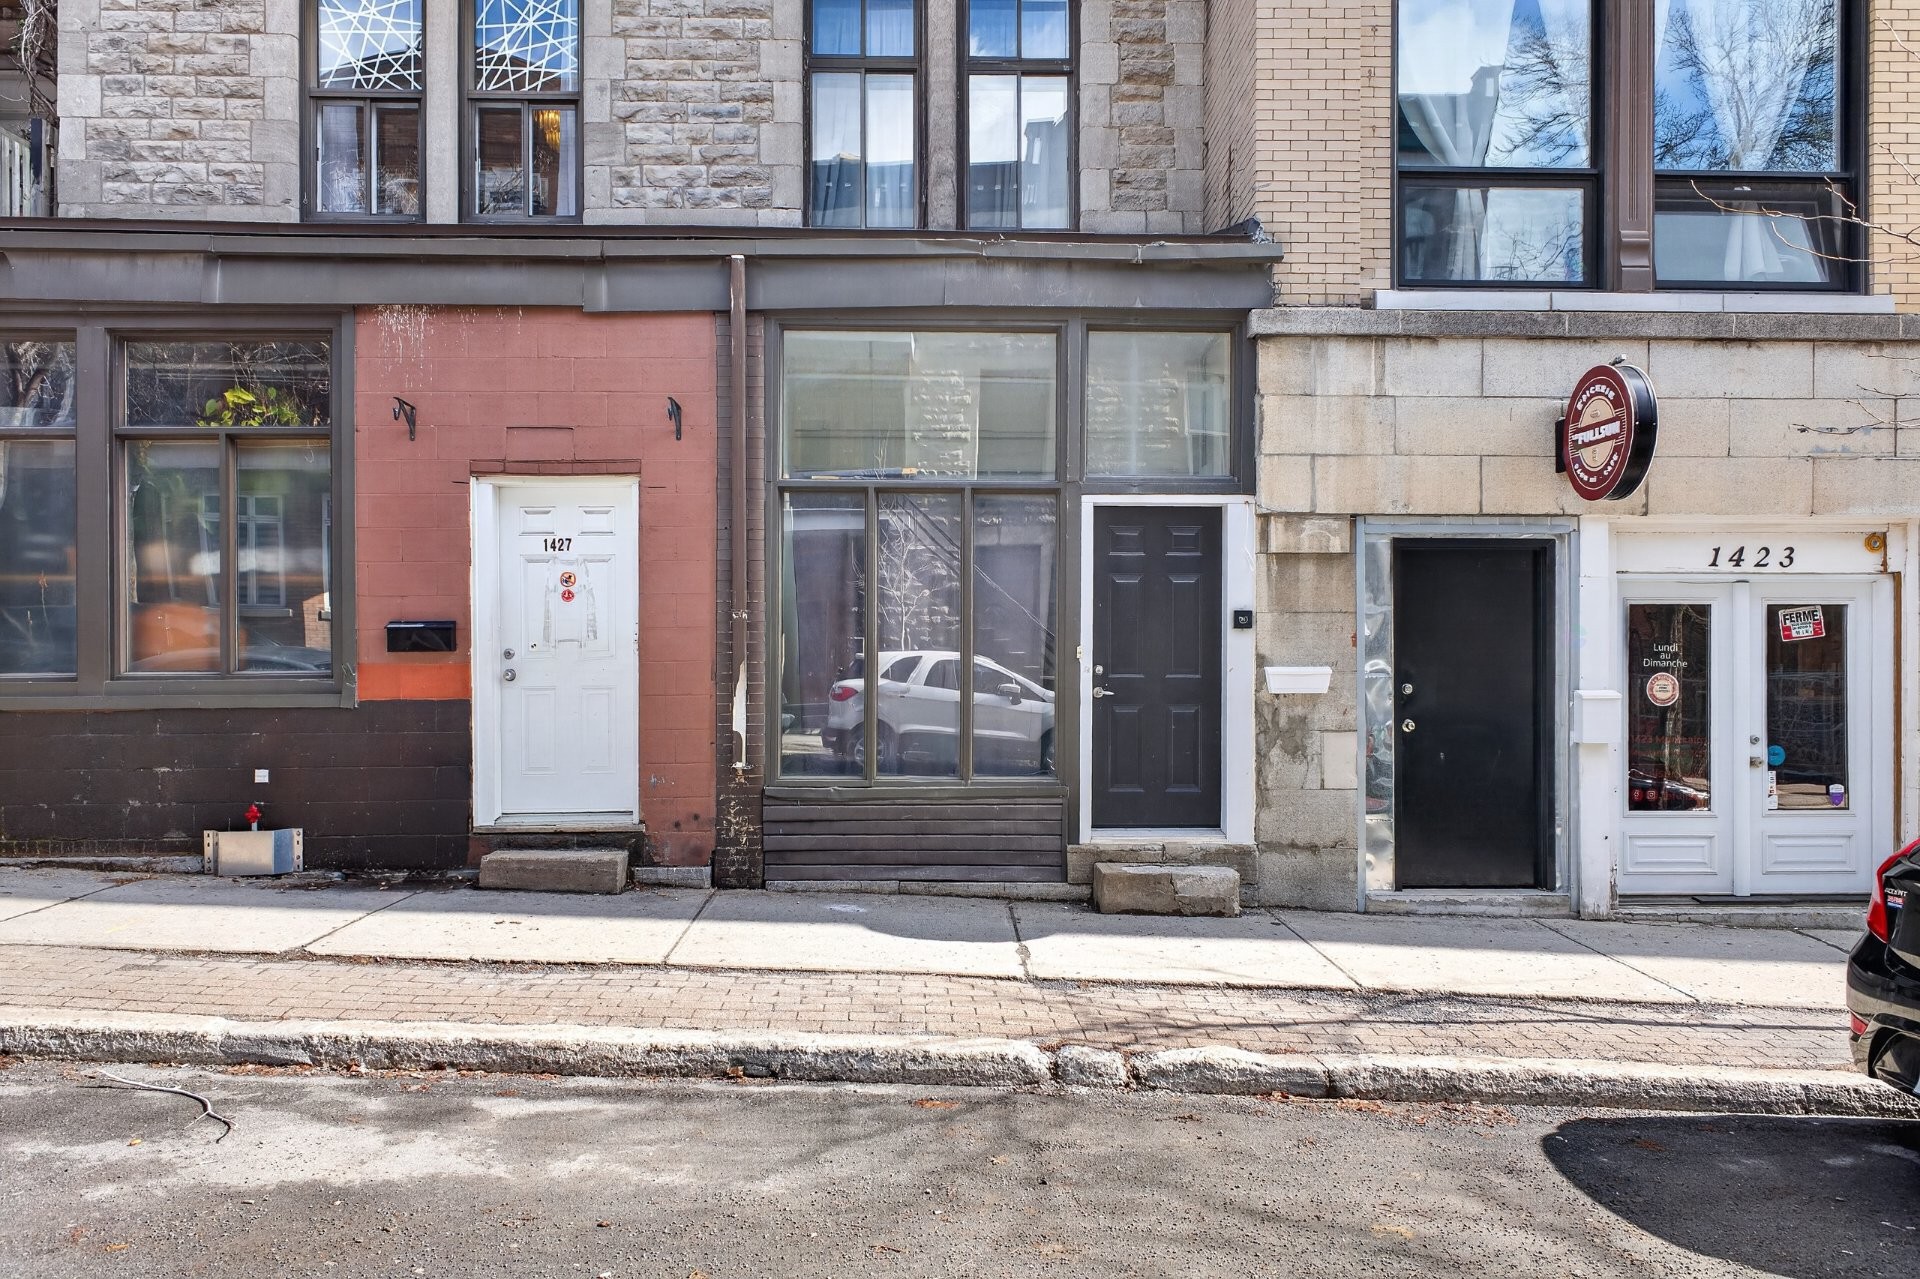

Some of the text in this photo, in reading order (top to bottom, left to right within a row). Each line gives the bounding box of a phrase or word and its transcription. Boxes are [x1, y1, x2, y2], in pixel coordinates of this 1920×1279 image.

[543, 537, 572, 552] 1427
[1708, 545, 1795, 568] 1423
[1653, 643, 1678, 652] Lundi
[1643, 658, 1688, 667] Dimanche
